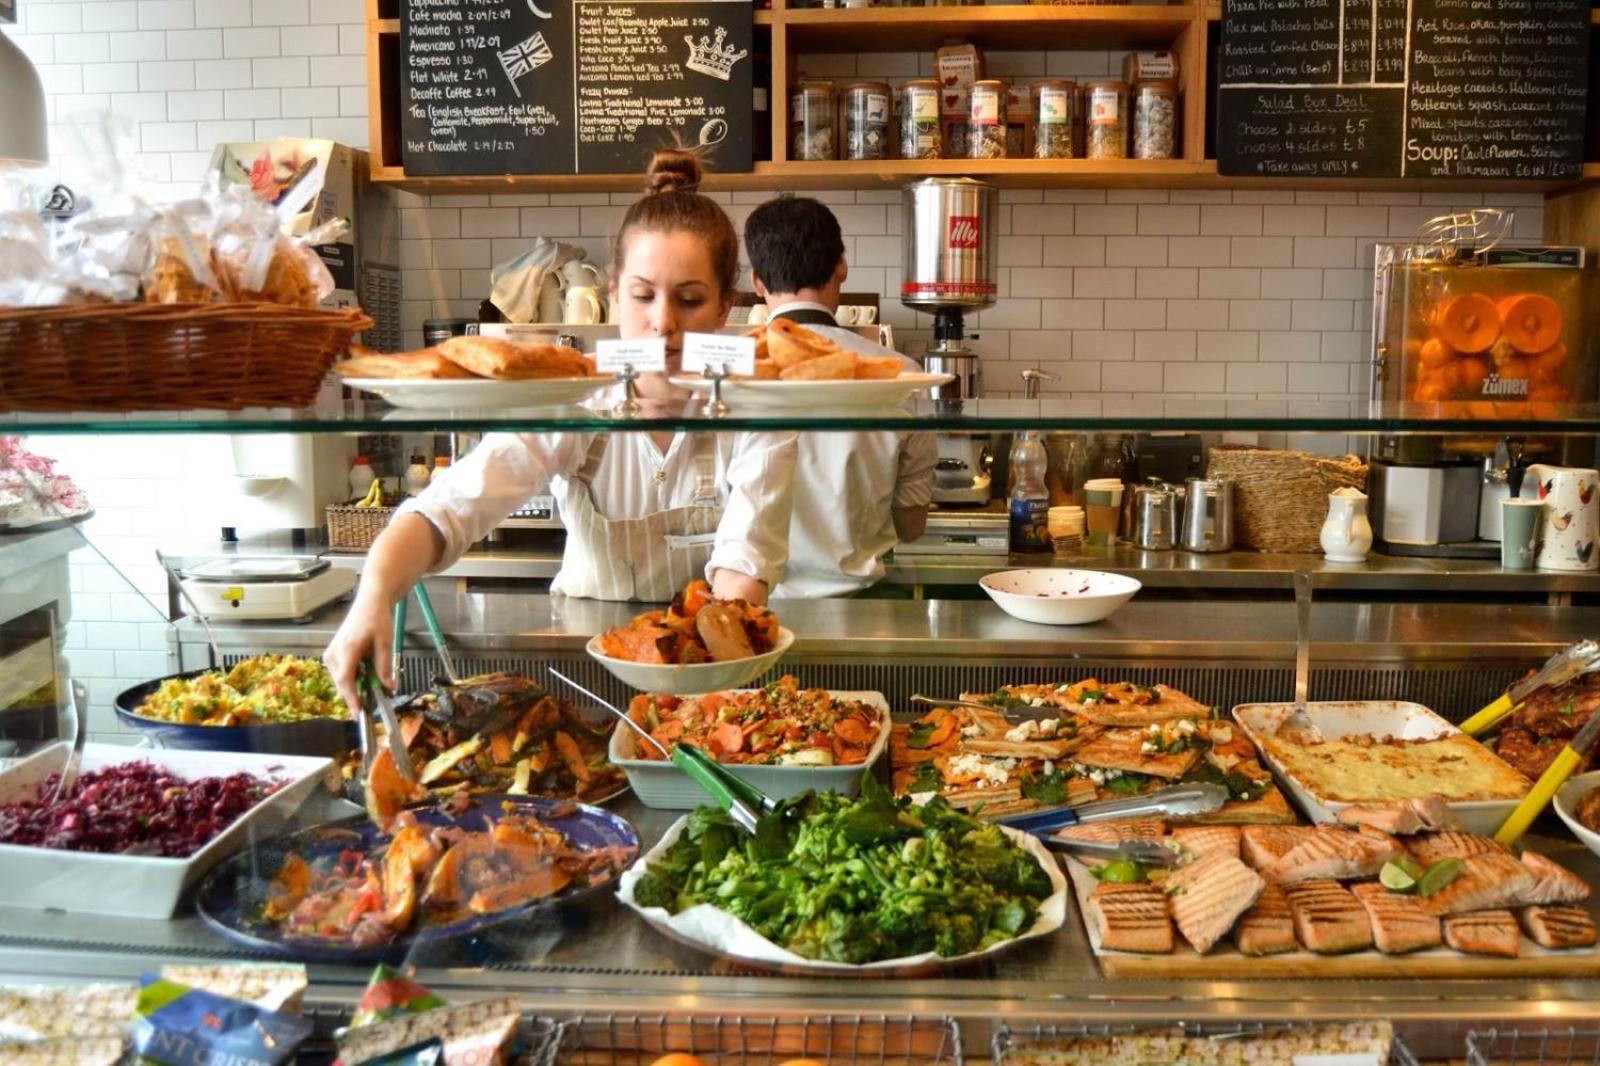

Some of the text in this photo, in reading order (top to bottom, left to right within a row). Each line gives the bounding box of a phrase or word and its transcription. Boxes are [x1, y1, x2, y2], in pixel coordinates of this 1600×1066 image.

[409, 9, 430, 21] Cafe
[580, 5, 603, 16] Fruit
[409, 40, 455, 52] Americano
[409, 55, 451, 68] Espresso
[410, 70, 428, 82] Flat
[445, 87, 473, 99] Coffee
[409, 104, 426, 118] Tea
[408, 140, 424, 152] Hot
[428, 140, 467, 152] Chocolate
[1407, 138, 1458, 167] Soup:
[950, 221, 979, 246] illy
